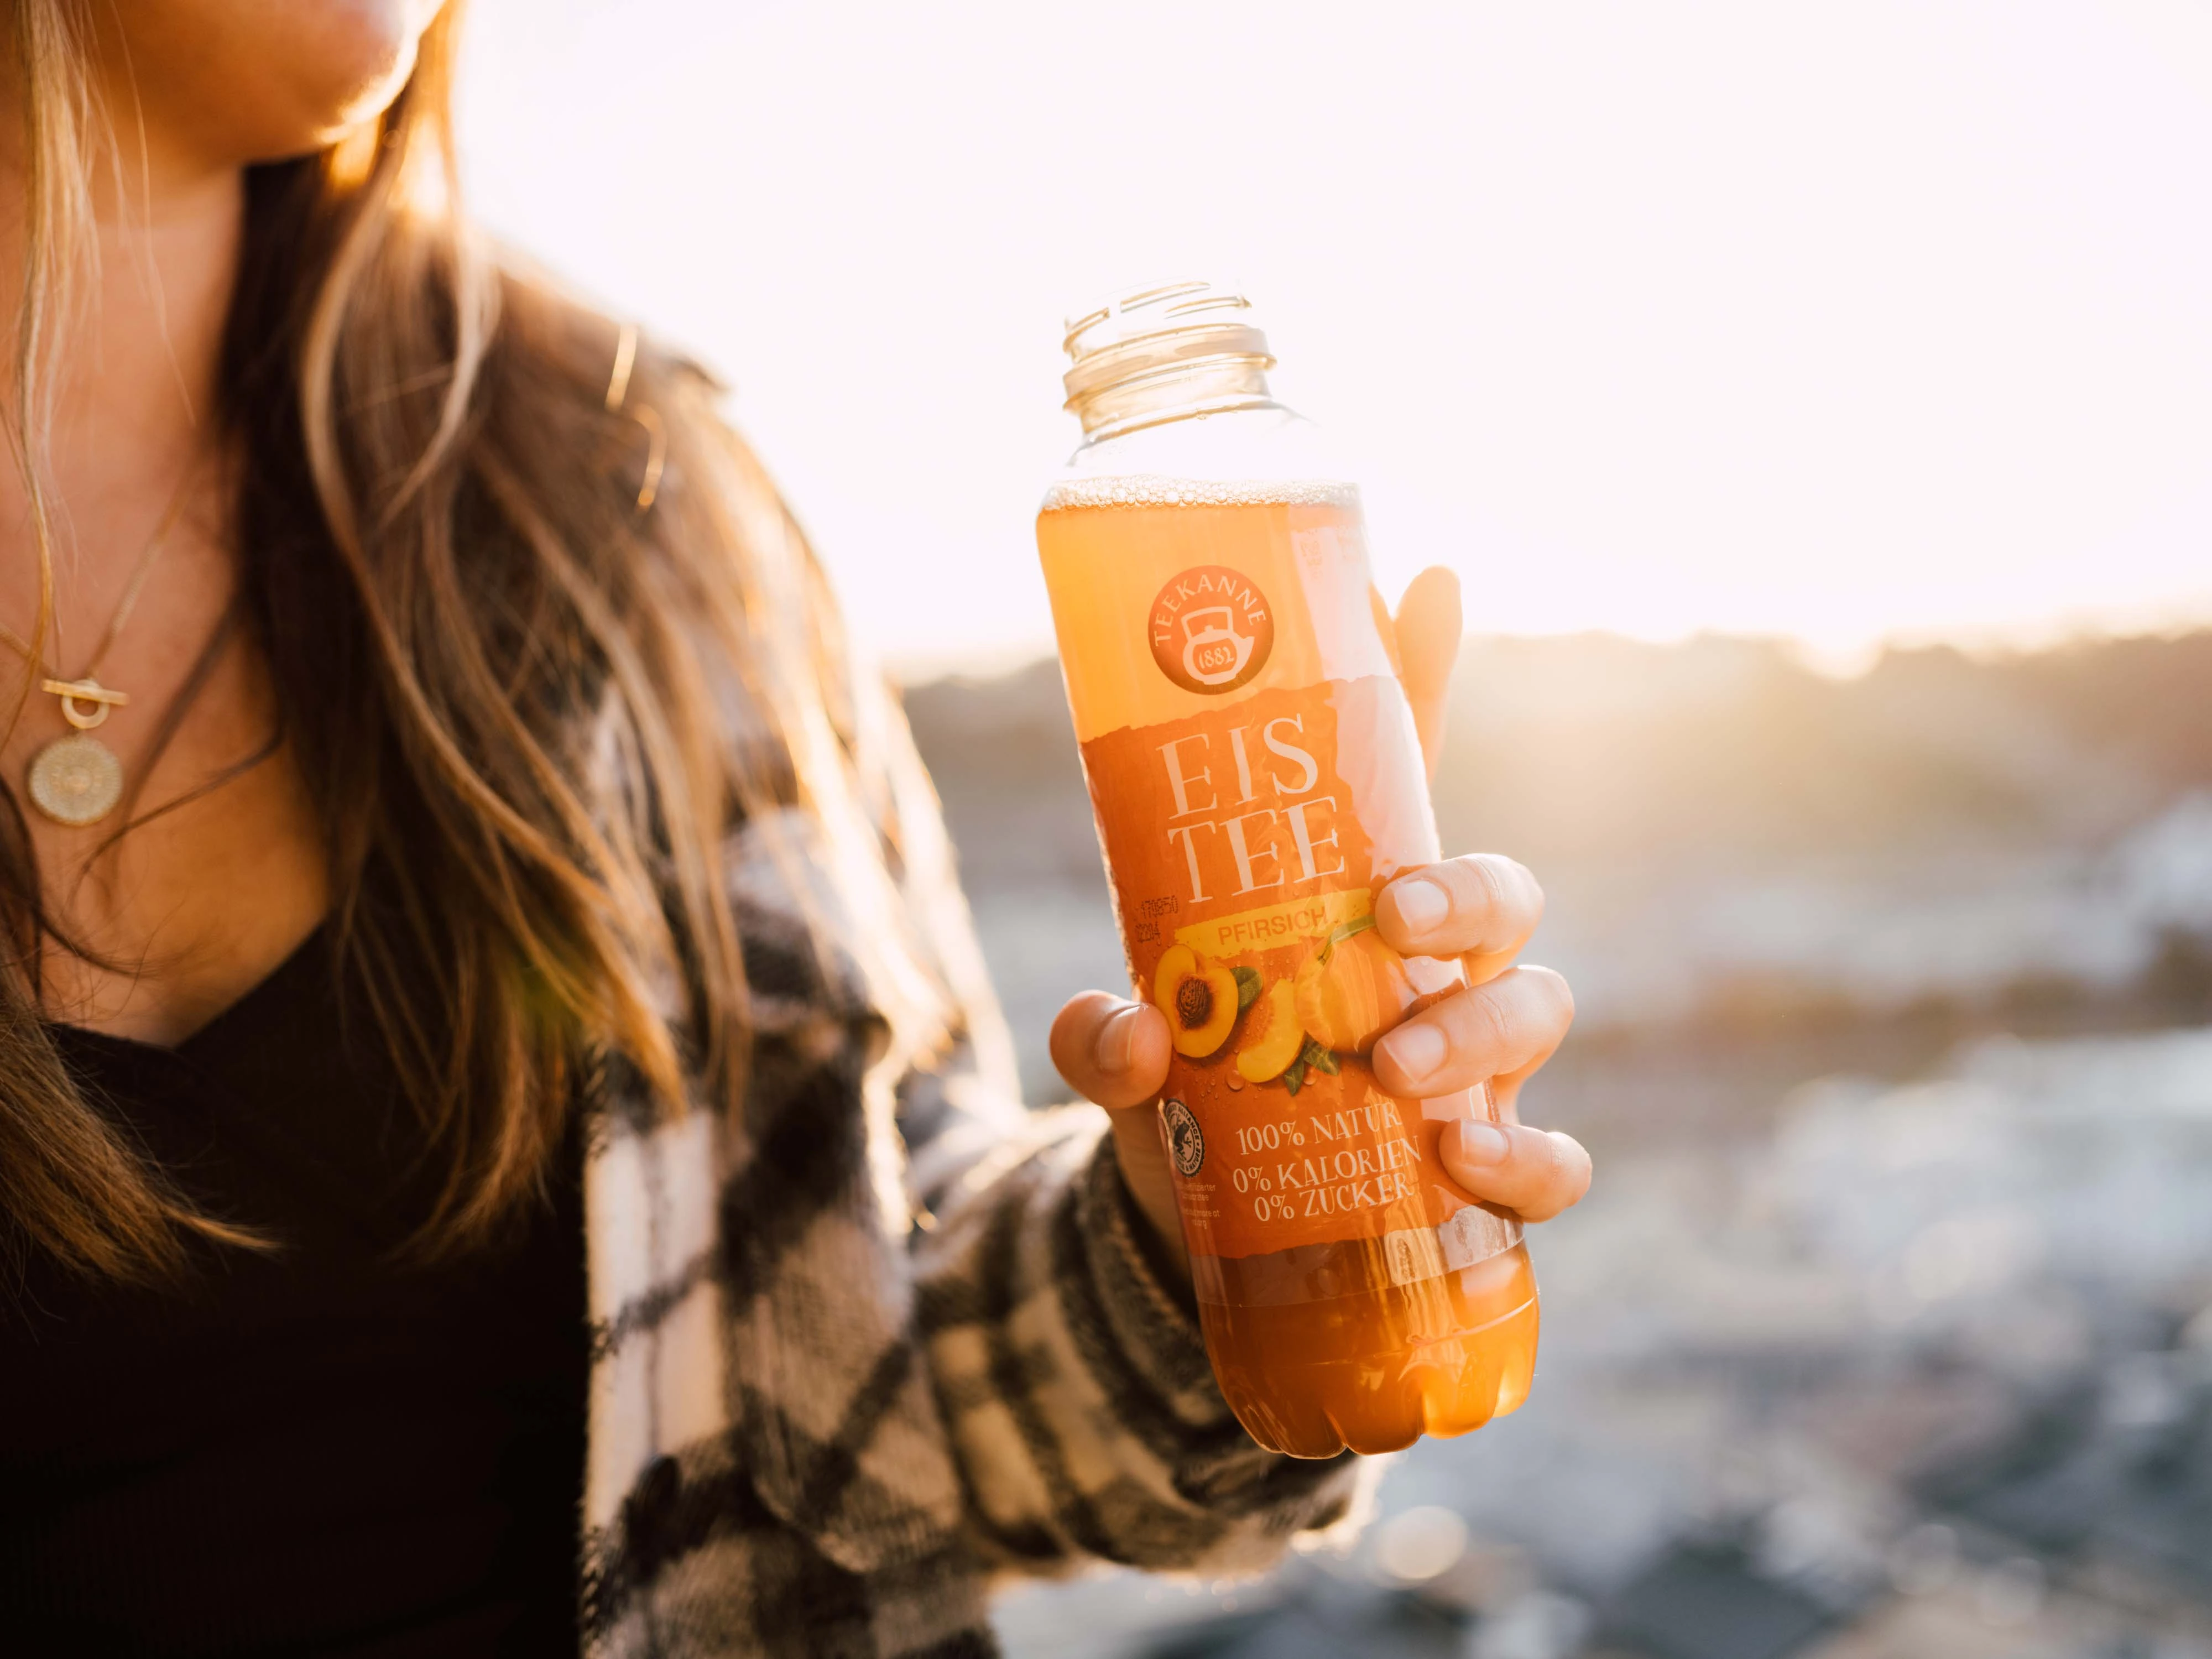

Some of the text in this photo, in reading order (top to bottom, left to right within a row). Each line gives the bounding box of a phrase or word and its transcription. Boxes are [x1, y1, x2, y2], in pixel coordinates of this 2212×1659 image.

[1154, 574, 1266, 646] TEEKANNE
[1198, 646, 1234, 670] 1882
[1155, 713, 1318, 820] EIS
[1167, 796, 1345, 903] TEE
[1218, 906, 1328, 945] PFIRSICH
[1235, 1102, 1402, 1155] 100% NATUR
[1233, 1135, 1422, 1193] 0% KALORIEN
[1254, 1172, 1415, 1222] 0% ZUCKER
